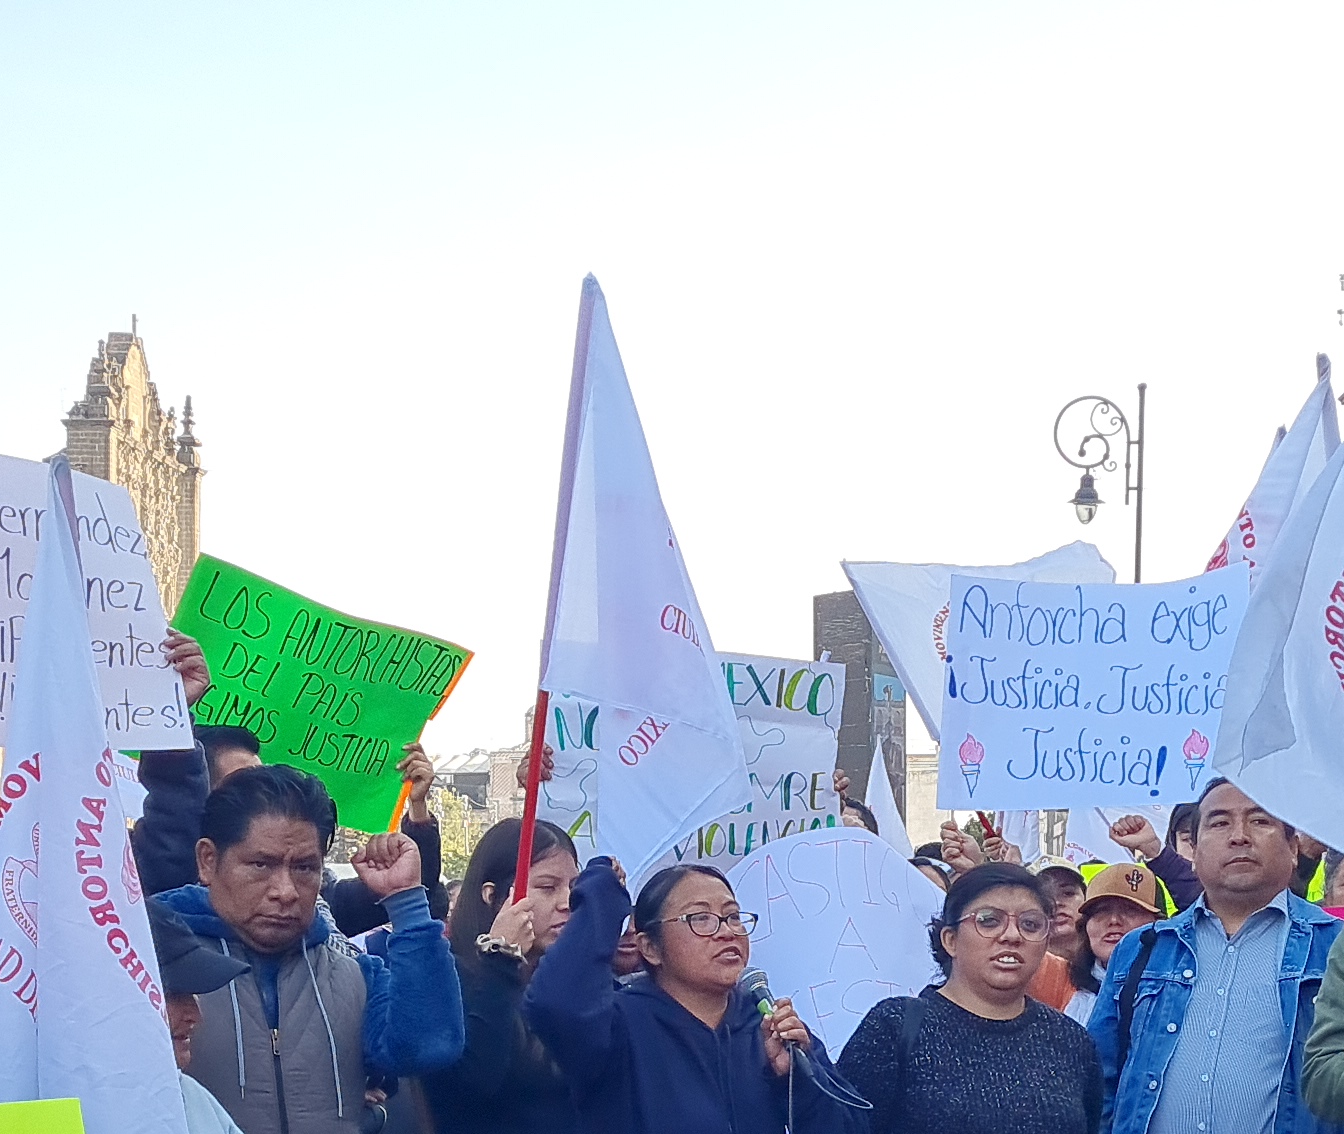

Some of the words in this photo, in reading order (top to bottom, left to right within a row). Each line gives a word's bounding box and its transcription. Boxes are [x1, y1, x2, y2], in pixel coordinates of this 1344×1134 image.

[199, 570, 273, 639] LOS
[1151, 585, 1228, 651] exige
[219, 641, 281, 698] DEL
[720, 661, 835, 716] EXICO
[195, 684, 280, 744] GIMOS
[288, 722, 390, 777] JUSTICIA
[1006, 726, 1168, 797] Justicia!
[829, 917, 878, 974] A
